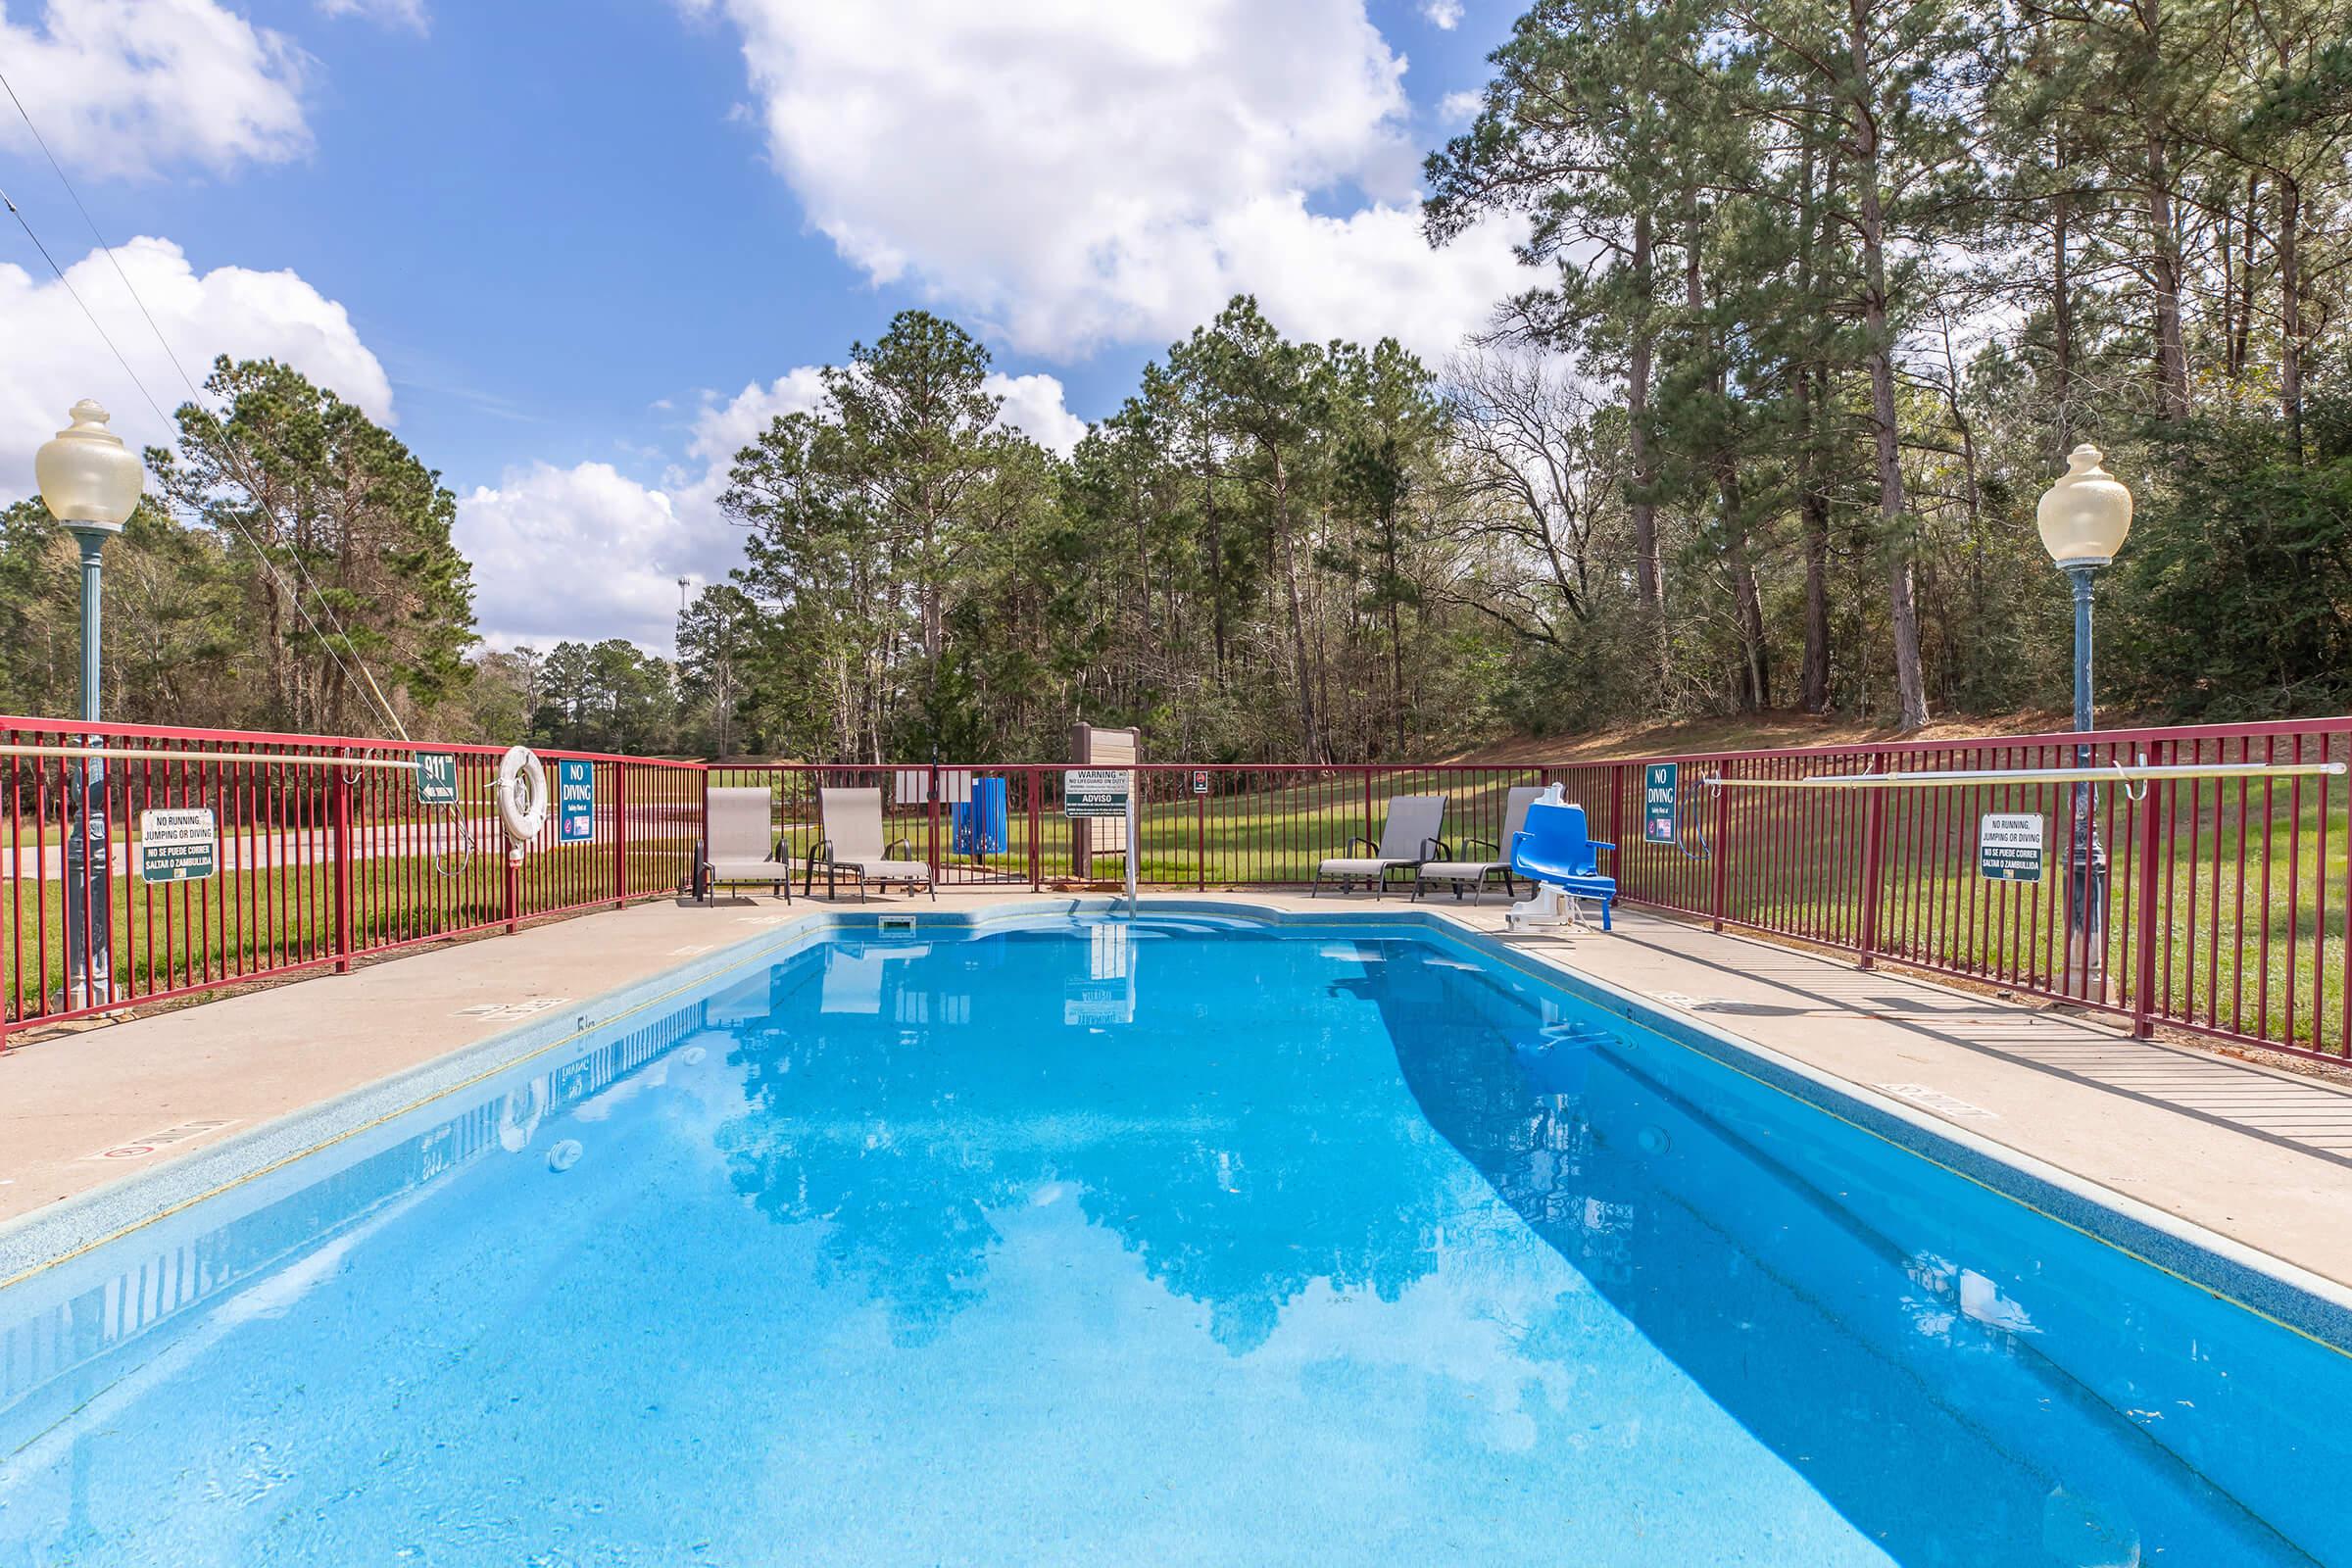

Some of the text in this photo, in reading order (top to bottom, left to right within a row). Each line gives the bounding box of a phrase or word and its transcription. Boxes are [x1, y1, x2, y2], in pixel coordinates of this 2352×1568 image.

[424, 756, 446, 780] 911
[570, 764, 584, 781] NO
[1654, 768, 1667, 784] NO
[563, 784, 591, 801] DIVING
[1082, 794, 1112, 803] ADVISO
[1647, 787, 1674, 804] DIVING
[156, 816, 167, 826] NO
[1991, 820, 2000, 829] NO
[145, 828, 212, 841] JUMPING OR DIVING
[1983, 832, 2040, 843] JUMPING OR DIVING
[148, 845, 210, 858] NO SE PUEDE CORRER
[1984, 848, 1992, 857] NO
[1999, 849, 2016, 858] PUEDE
[2016, 850, 2037, 858] CORRER
[145, 857, 213, 870] SALTAR O ZAMBULLIDA
[1983, 858, 2039, 870] SALTAR O ZAMBULLIDA
